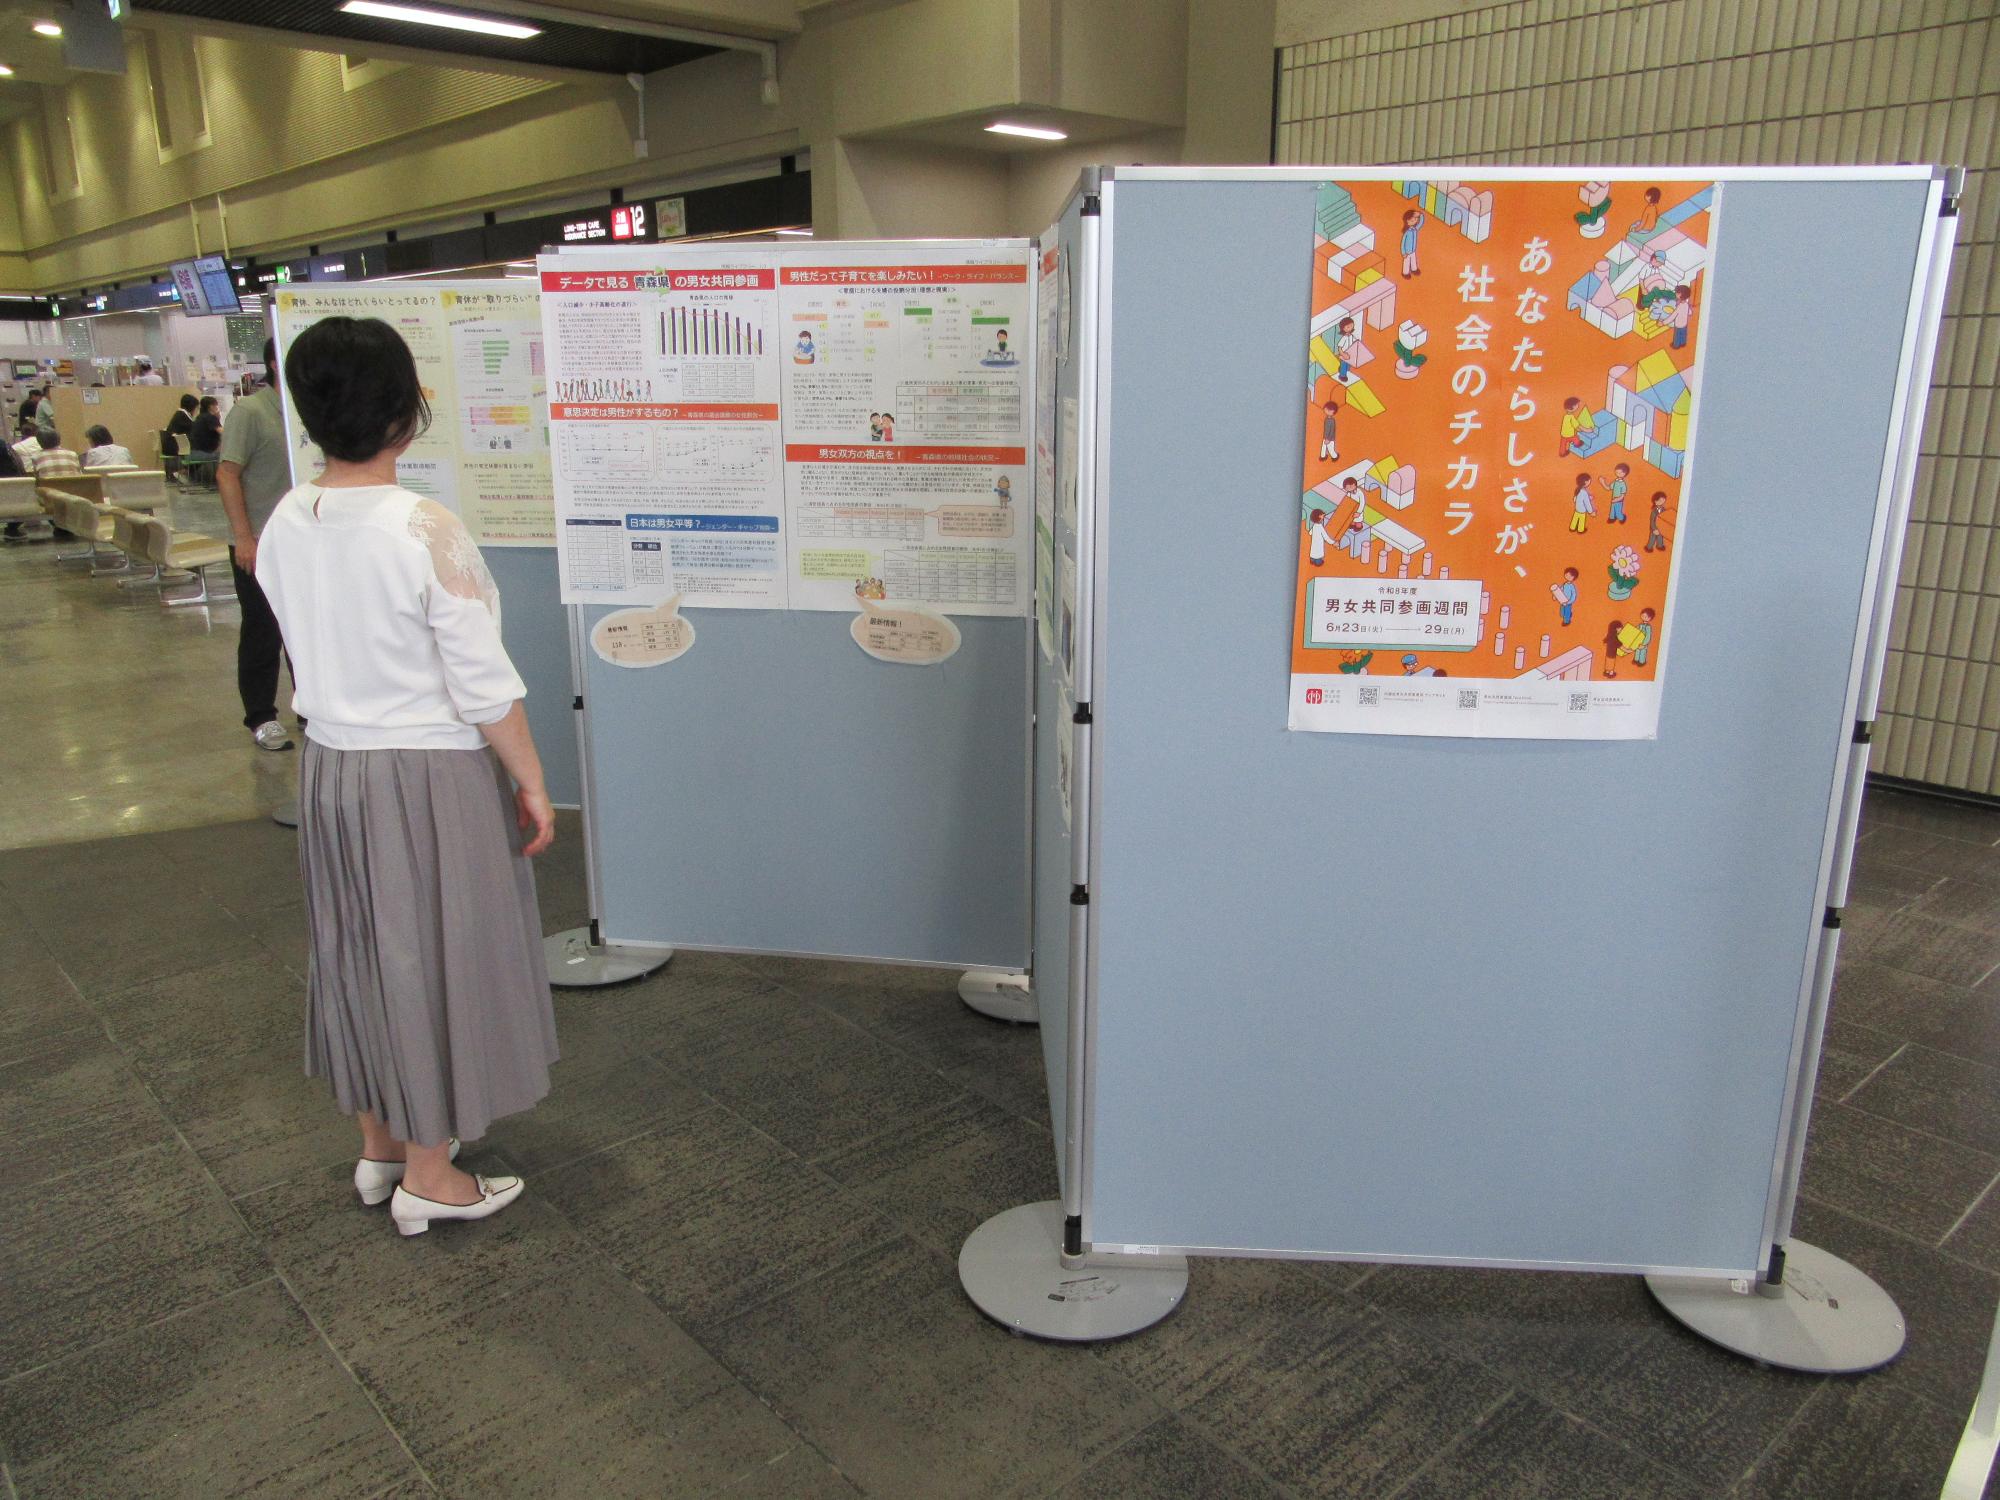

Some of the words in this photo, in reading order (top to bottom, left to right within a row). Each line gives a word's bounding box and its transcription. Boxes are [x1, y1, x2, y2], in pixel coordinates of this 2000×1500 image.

[630, 205, 646, 237] 12
[1444, 264, 1495, 536] 社会のチカラ
[1495, 235, 1552, 578] あなたらしさが、
[629, 518, 700, 530] 日本は男女平等？
[1377, 586, 1419, 596] 令和8年度
[1325, 598, 1469, 617] 男女共同参画週間
